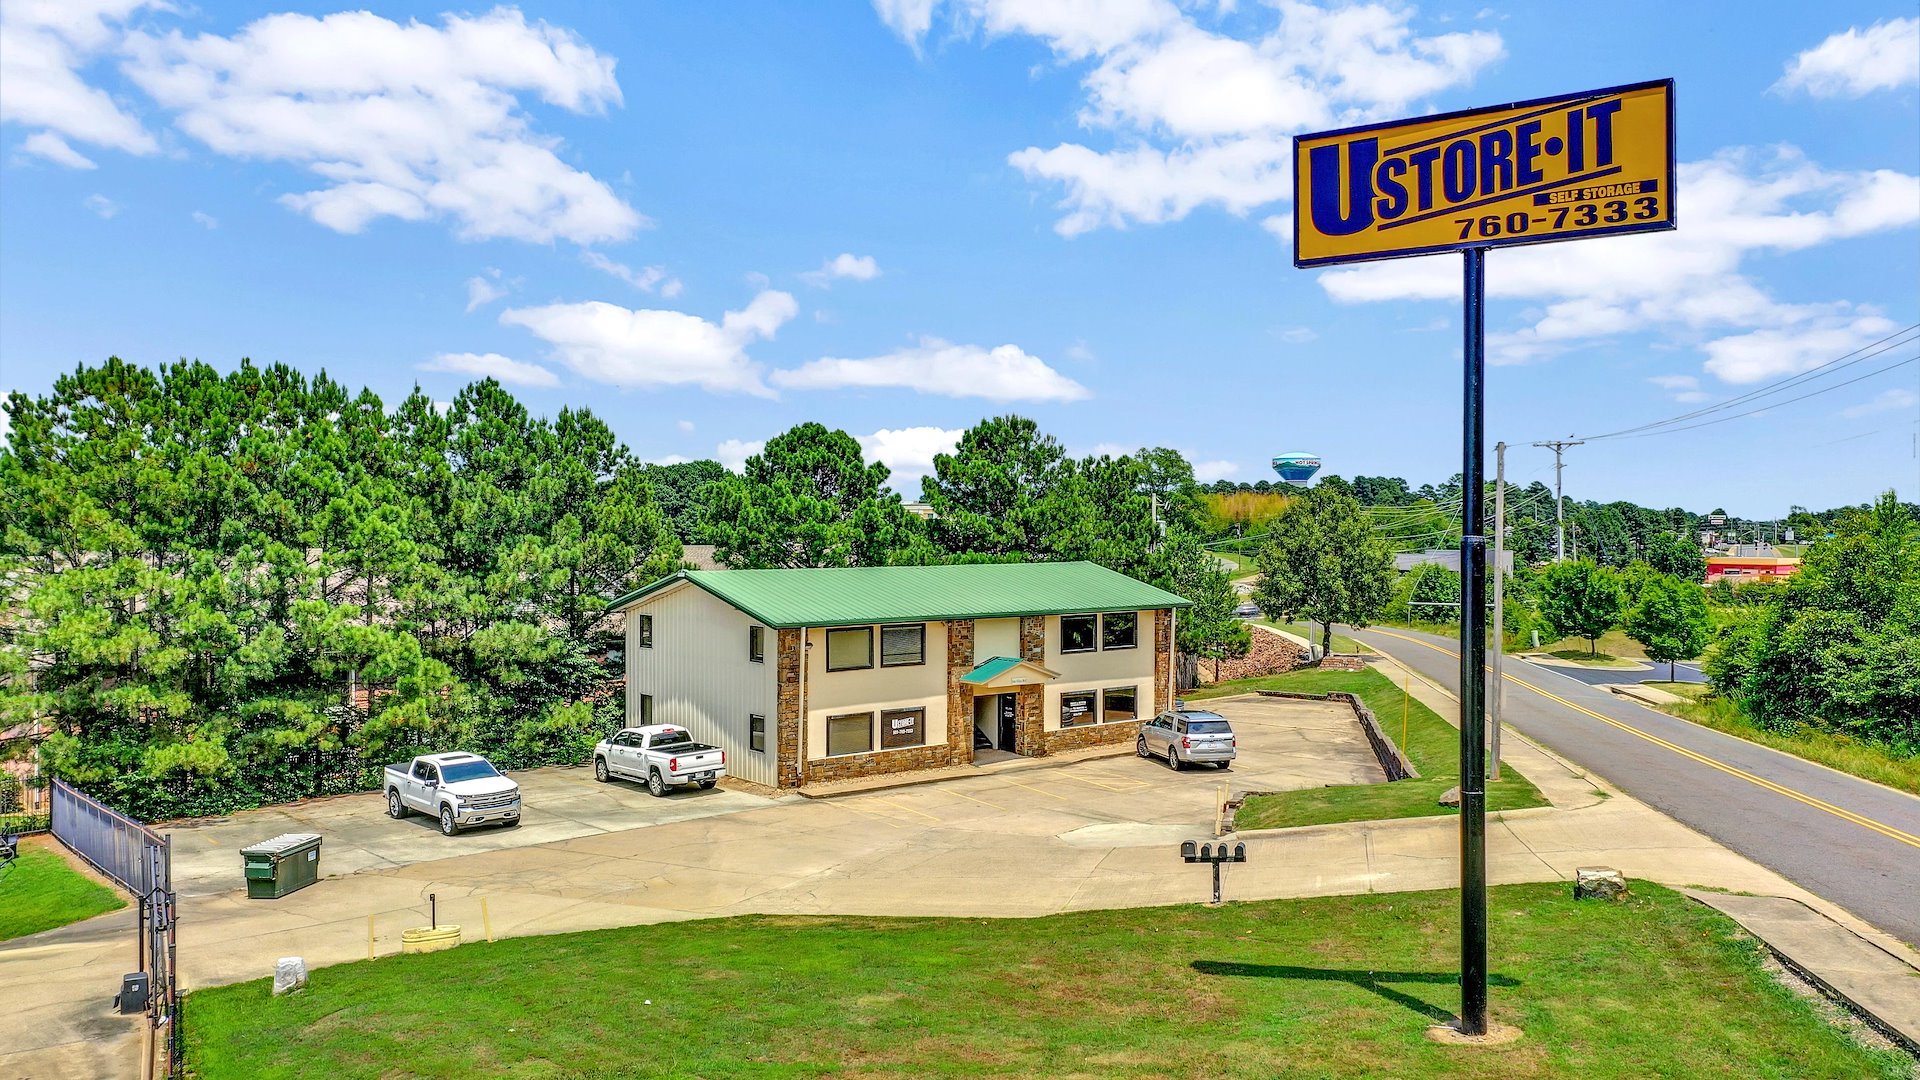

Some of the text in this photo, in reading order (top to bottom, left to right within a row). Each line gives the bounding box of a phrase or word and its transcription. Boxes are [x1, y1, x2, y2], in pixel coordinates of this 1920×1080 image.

[1549, 182, 1641, 204] SELF STORAGE
[1454, 196, 1659, 240] 760-7333
